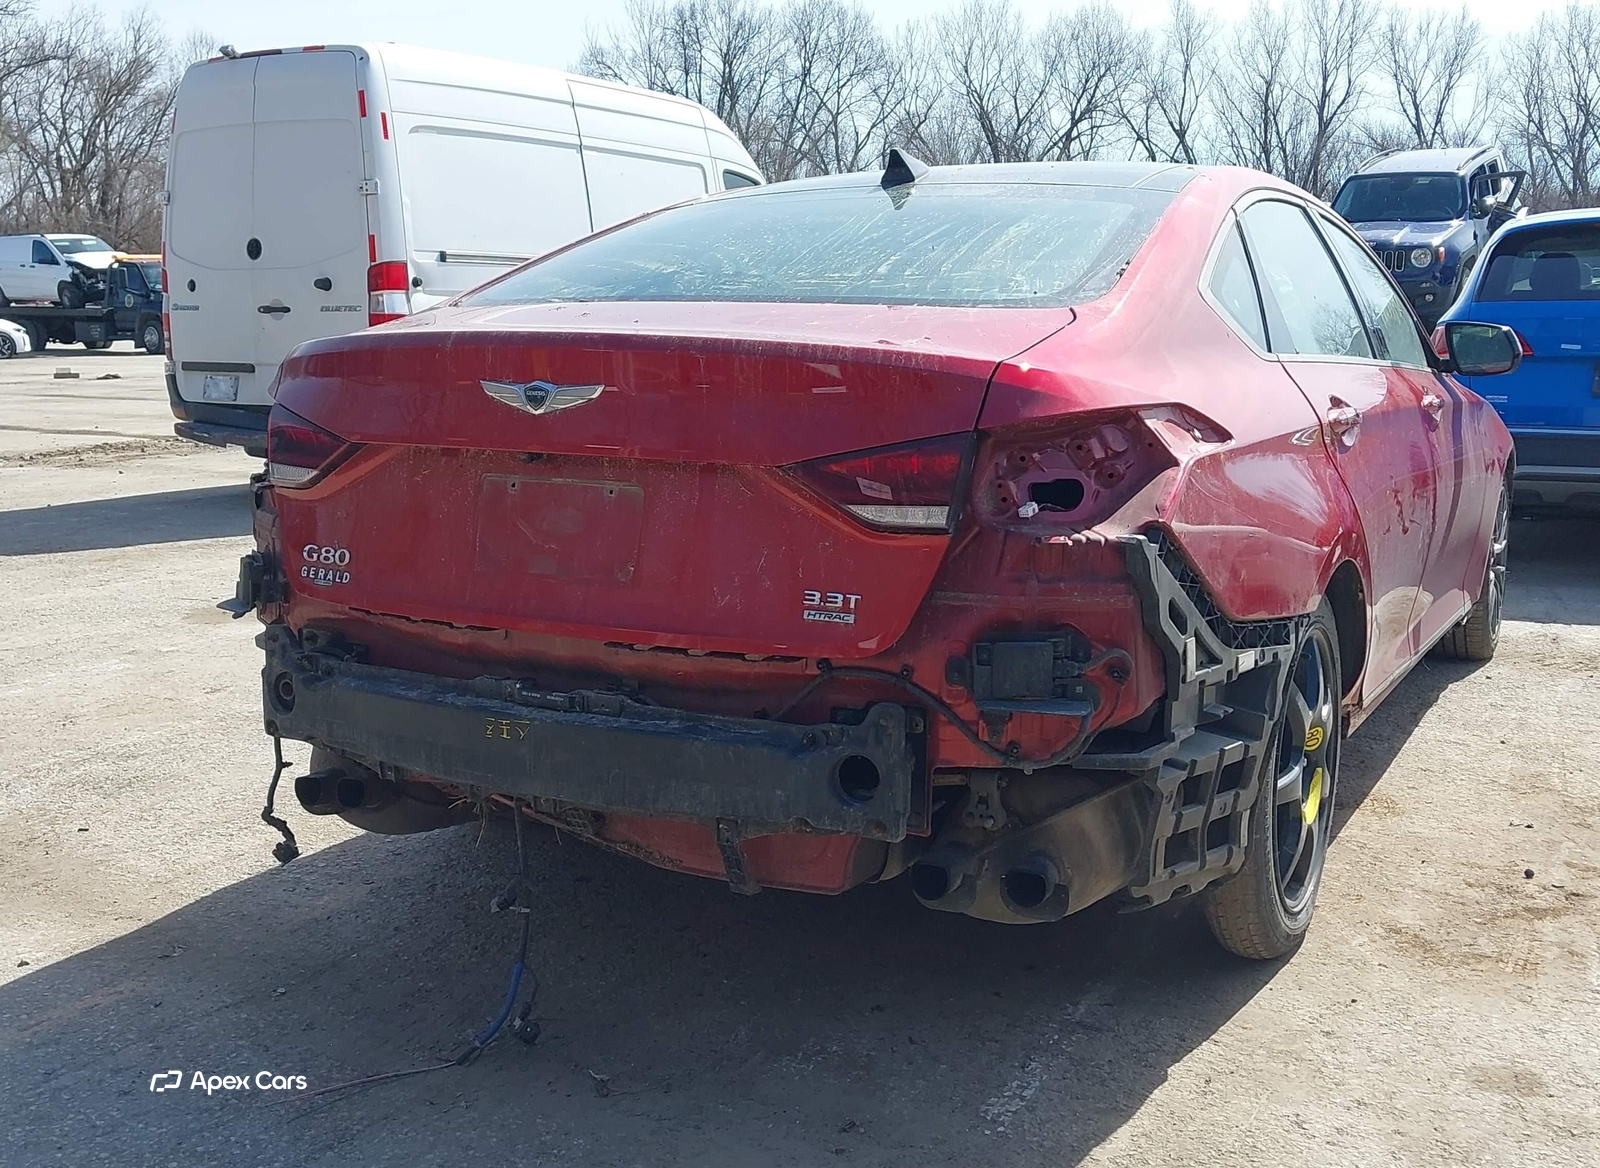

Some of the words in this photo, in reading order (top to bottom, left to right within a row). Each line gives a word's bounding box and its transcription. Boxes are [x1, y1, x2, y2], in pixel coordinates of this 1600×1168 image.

[302, 544, 350, 566] G80
[301, 566, 350, 583] GERALD
[802, 590, 862, 609] 3.3T
[806, 611, 852, 621] HTRAC
[1306, 729, 1320, 747] 80
